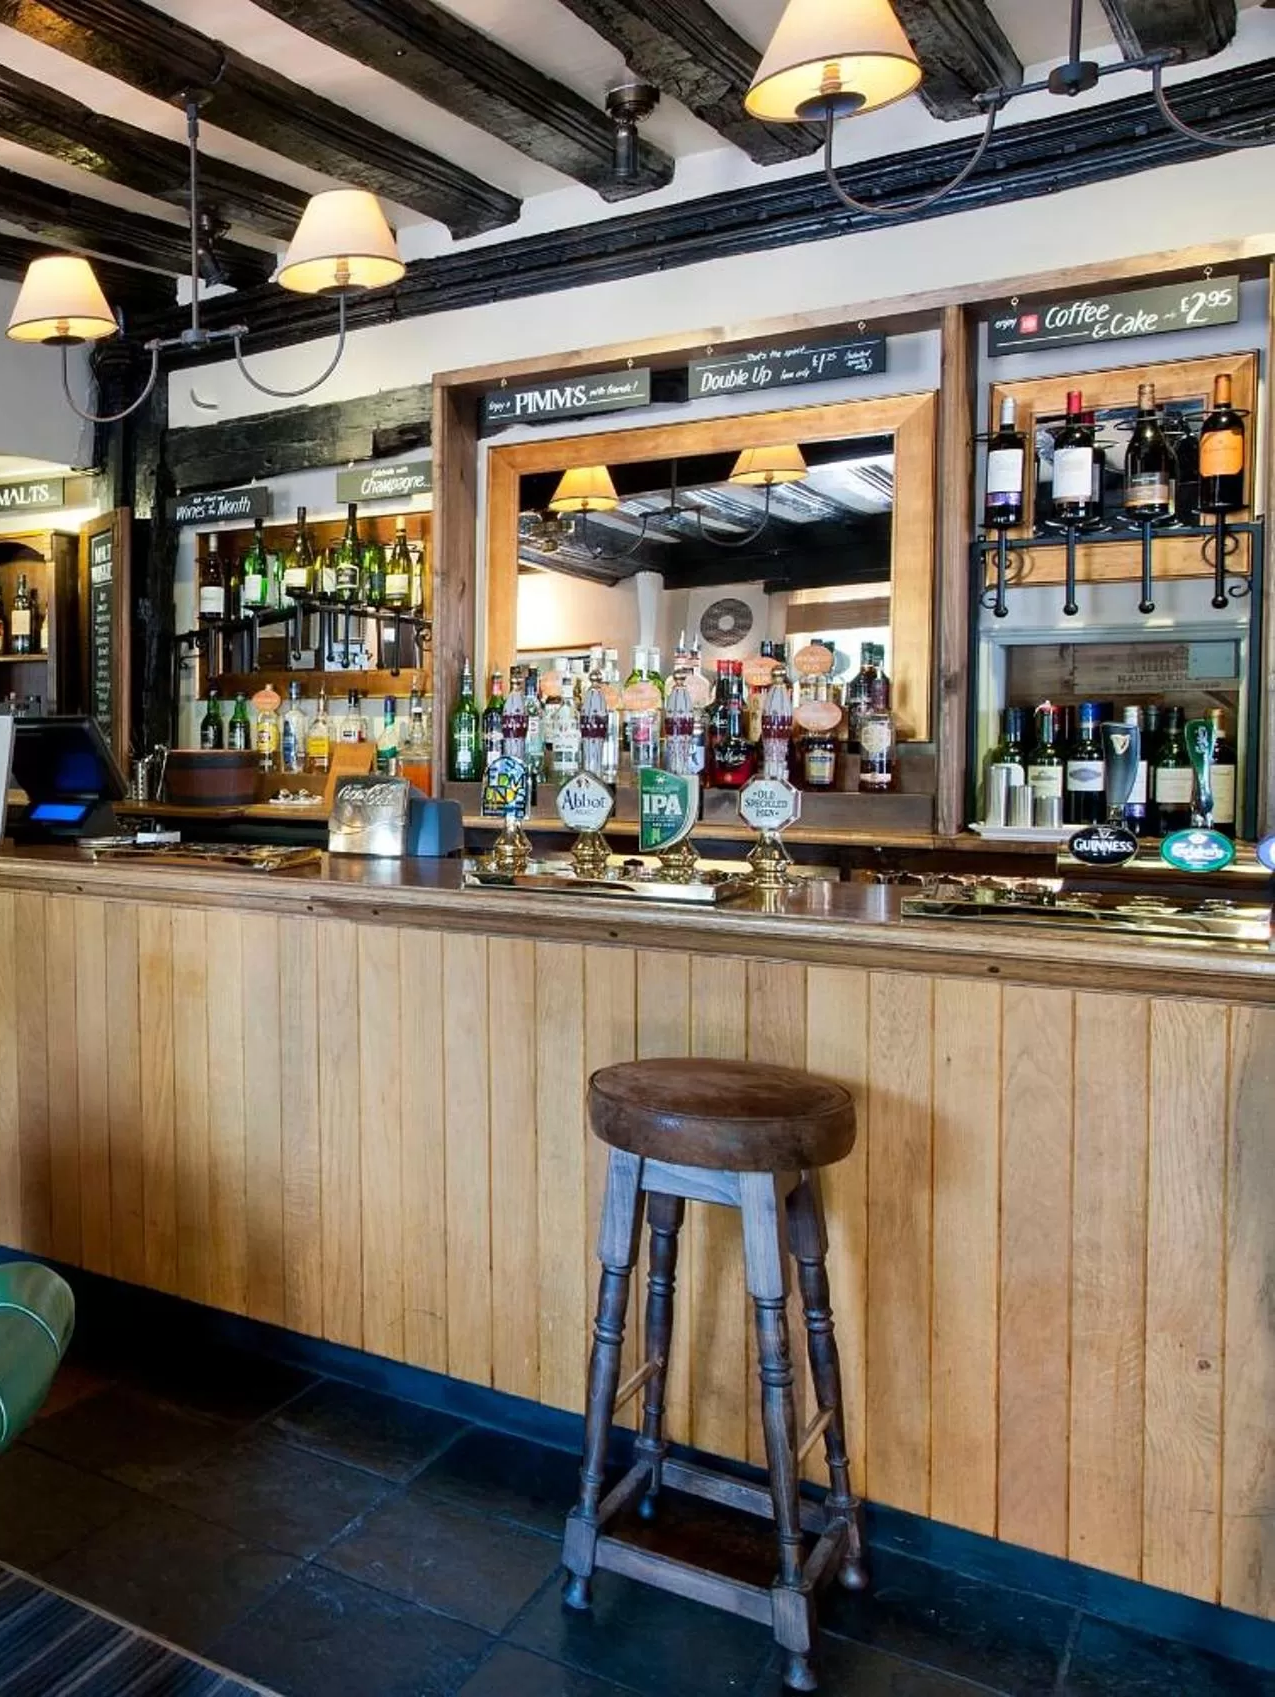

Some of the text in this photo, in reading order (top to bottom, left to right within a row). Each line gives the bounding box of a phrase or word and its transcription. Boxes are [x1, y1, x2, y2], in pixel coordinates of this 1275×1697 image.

[1045, 301, 1110, 328] Coffee
[1110, 309, 1158, 335] Cake
[700, 368, 749, 392] Double
[752, 365, 772, 386] Up
[515, 385, 587, 415] PIMM'S
[176, 505, 205, 520] Wines
[217, 496, 250, 515] Month
[562, 789, 606, 810] Abbot
[642, 793, 682, 815] IPA
[1073, 838, 1135, 853] GUINNESS
